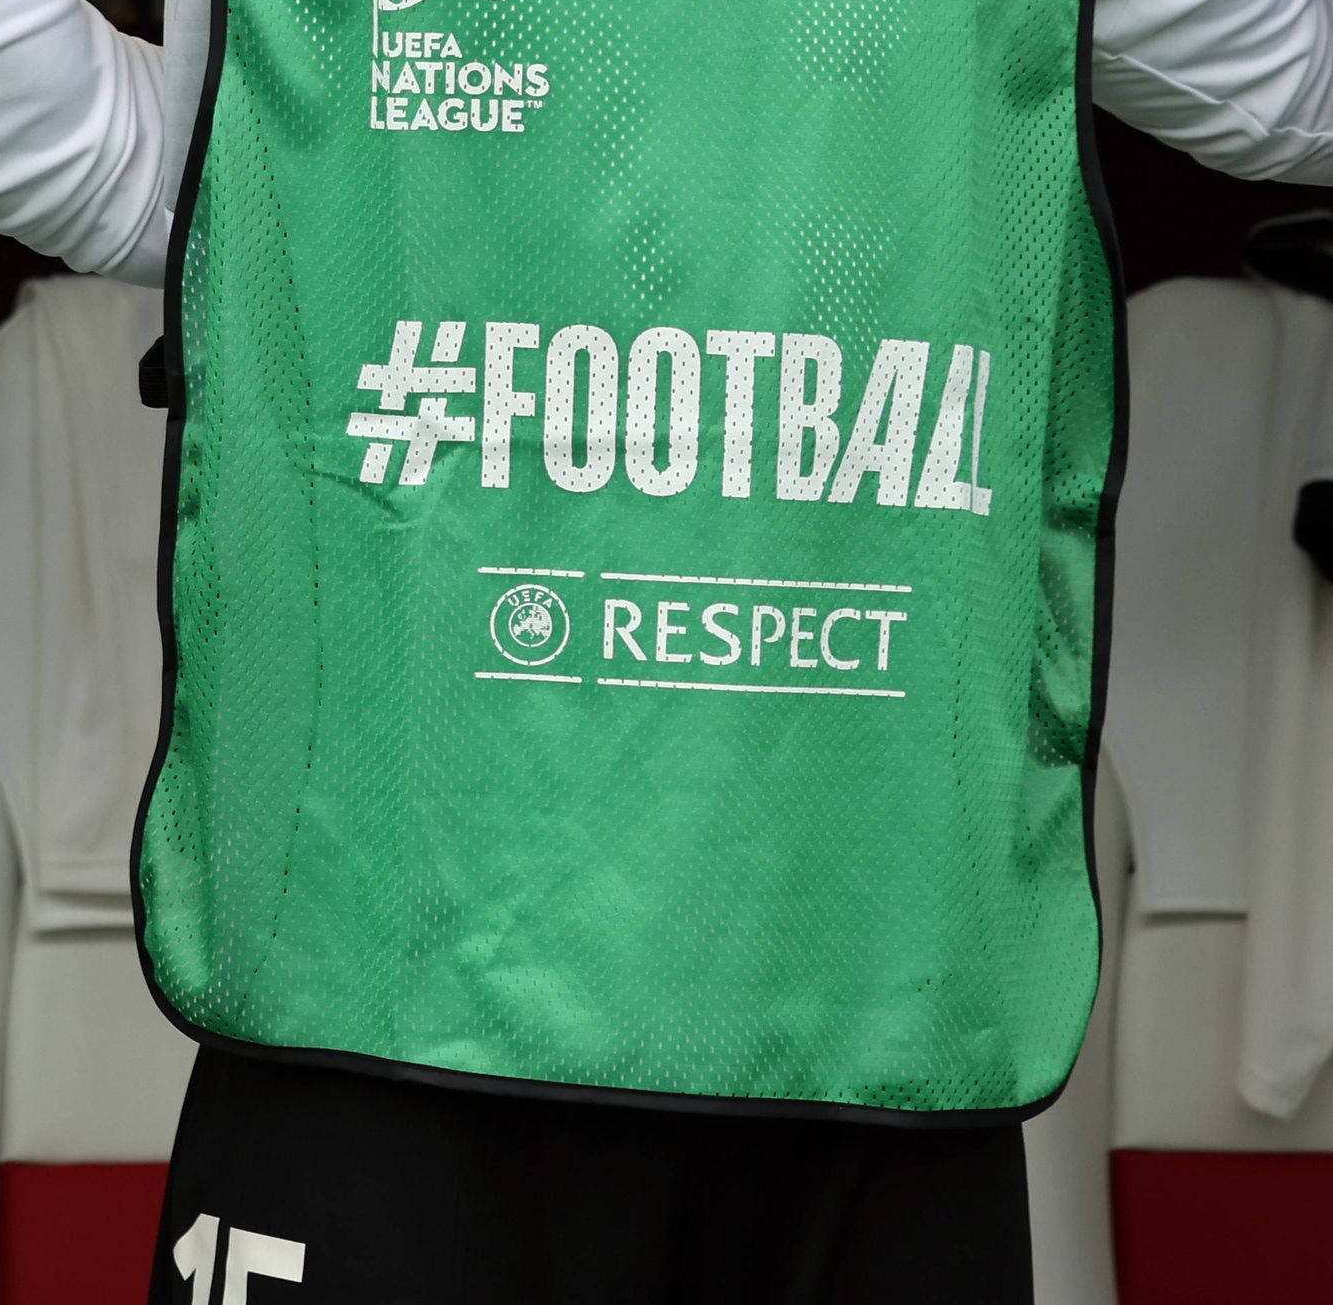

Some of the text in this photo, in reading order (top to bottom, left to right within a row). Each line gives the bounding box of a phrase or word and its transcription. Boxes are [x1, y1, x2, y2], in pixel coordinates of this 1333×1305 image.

[382, 31, 463, 58] UEFA
[371, 60, 550, 97] NATIONS
[507, 590, 553, 608] UEFA
[602, 598, 908, 671] RESPECT
